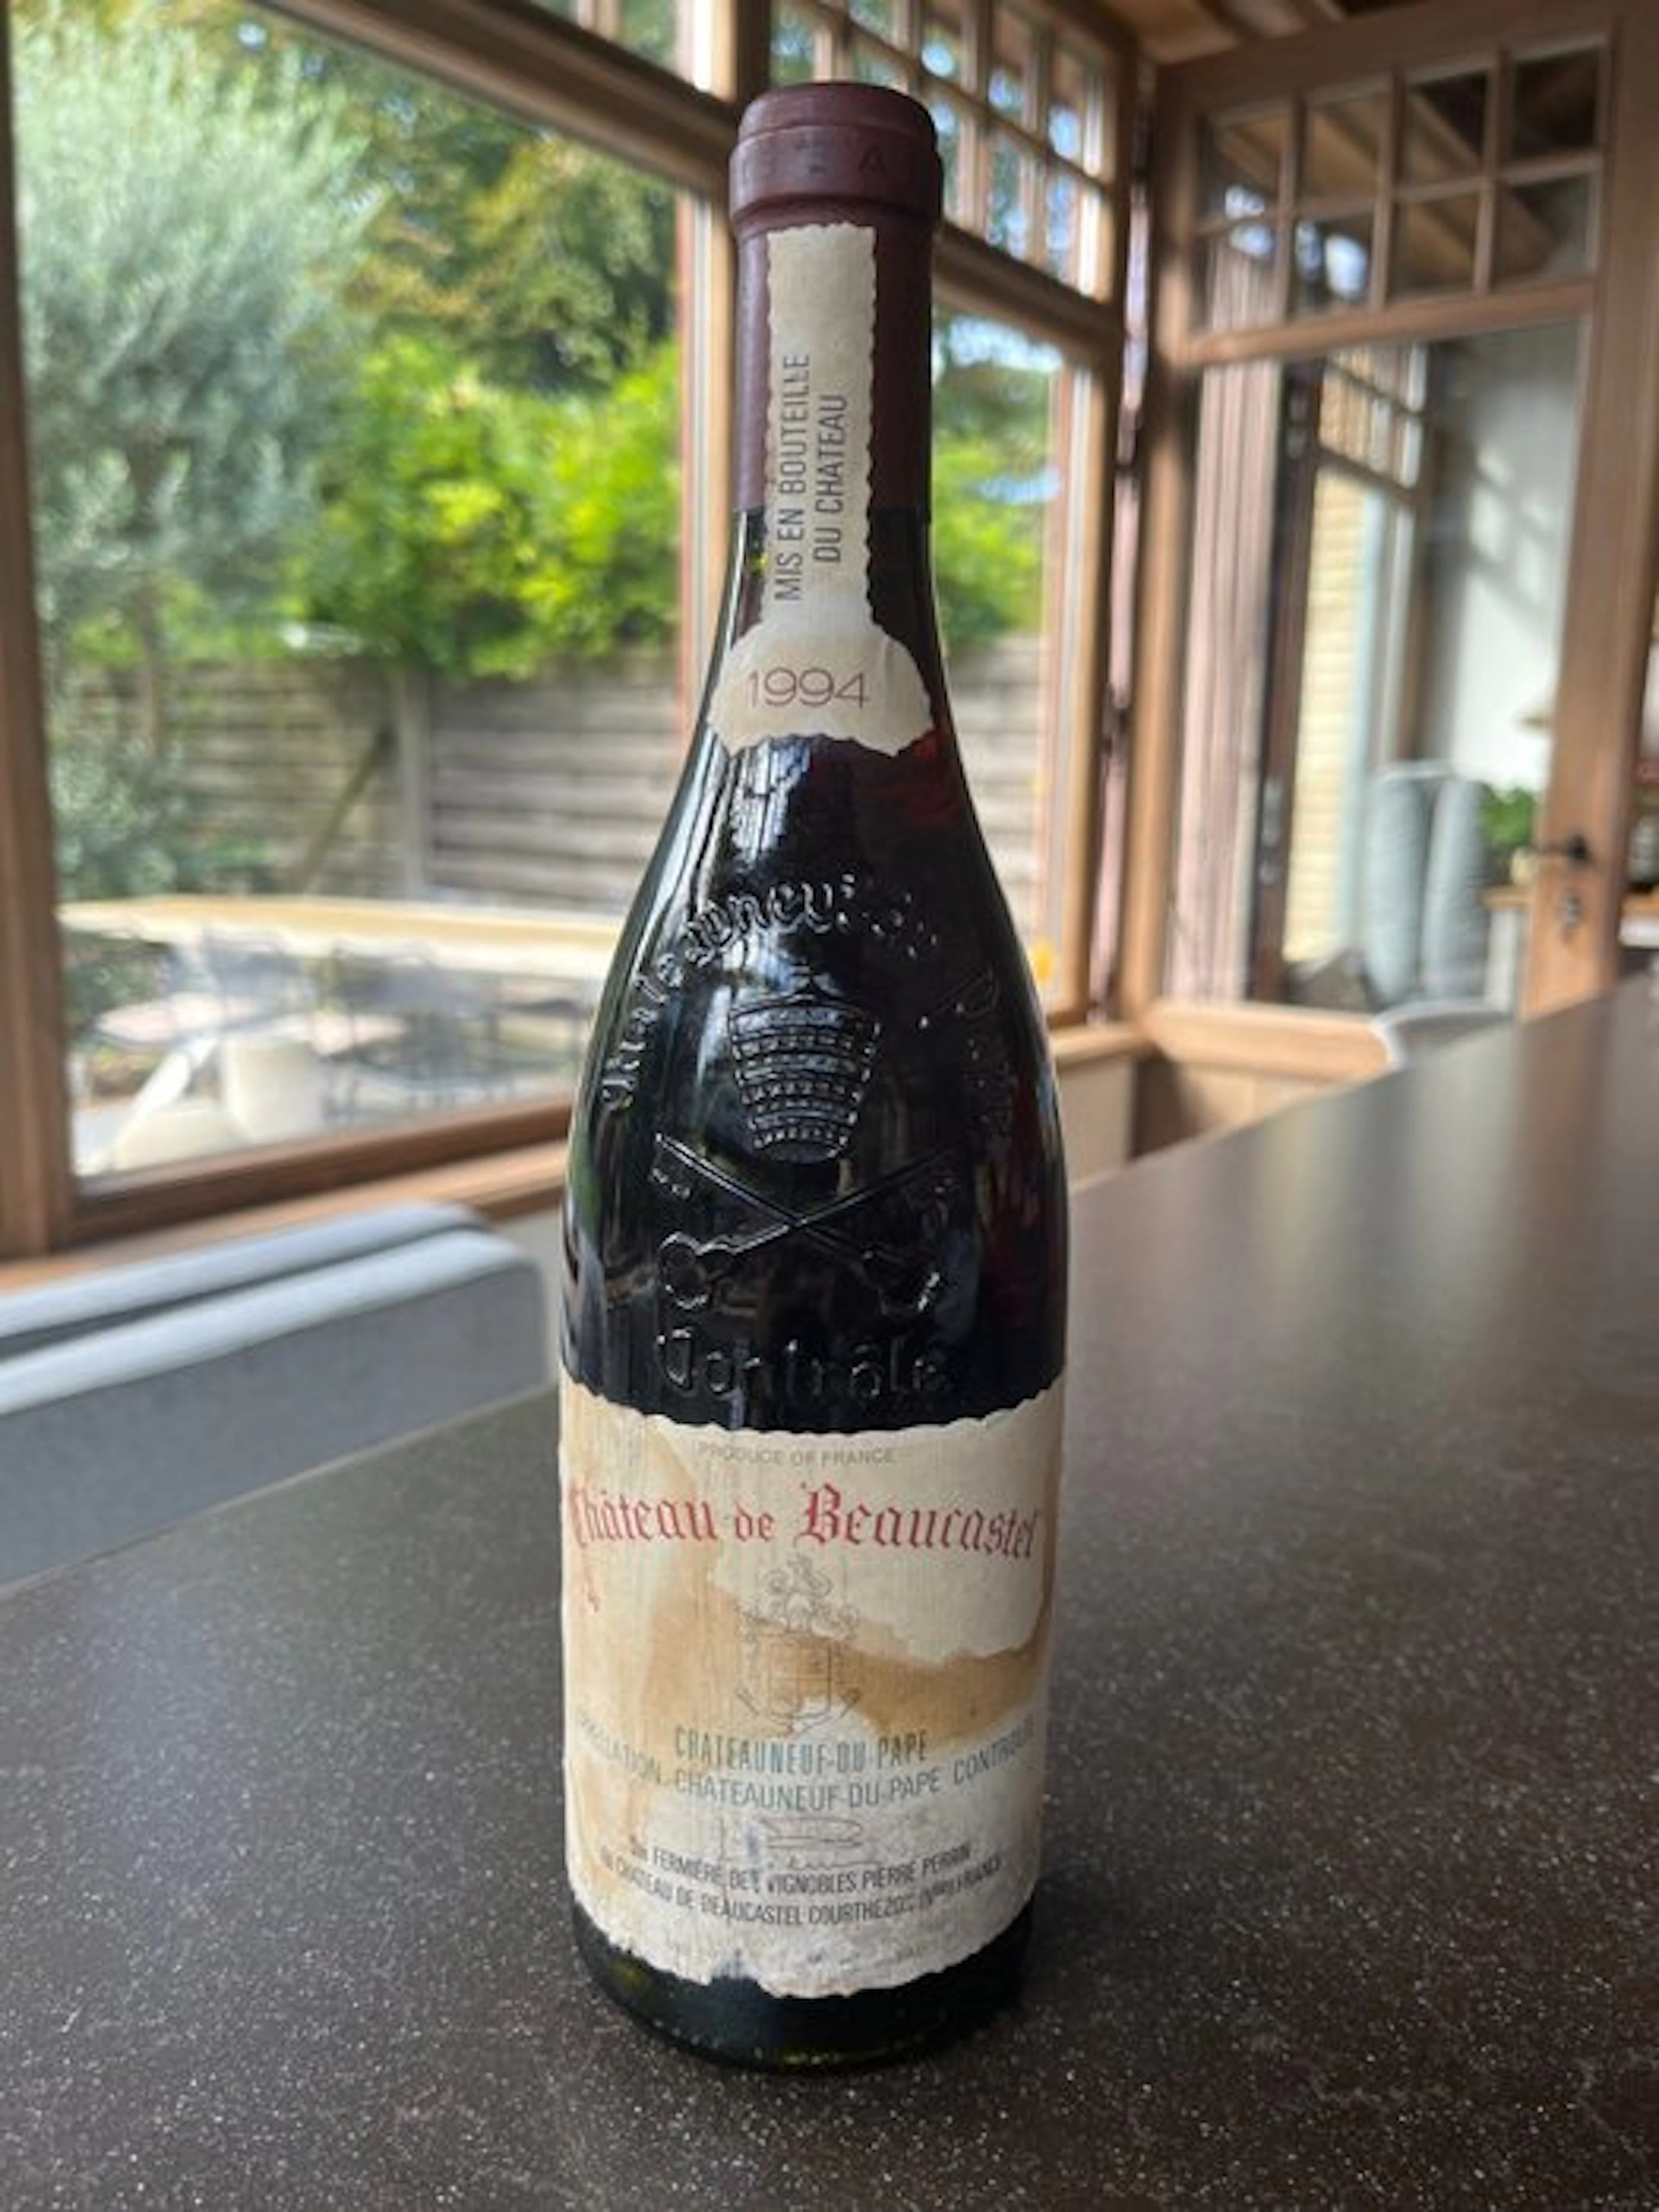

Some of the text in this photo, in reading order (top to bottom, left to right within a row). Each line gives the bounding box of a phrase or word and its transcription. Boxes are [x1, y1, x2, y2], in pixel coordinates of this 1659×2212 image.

[775, 355, 809, 601] MIS EN BOUTEILLE
[814, 528, 842, 563] DU
[747, 667, 869, 709] 1994
[790, 1449, 816, 1467] OF
[822, 1447, 898, 1467] FRANCE
[734, 1503, 774, 1541] de
[794, 1482, 1038, 1559] Beaucastel
